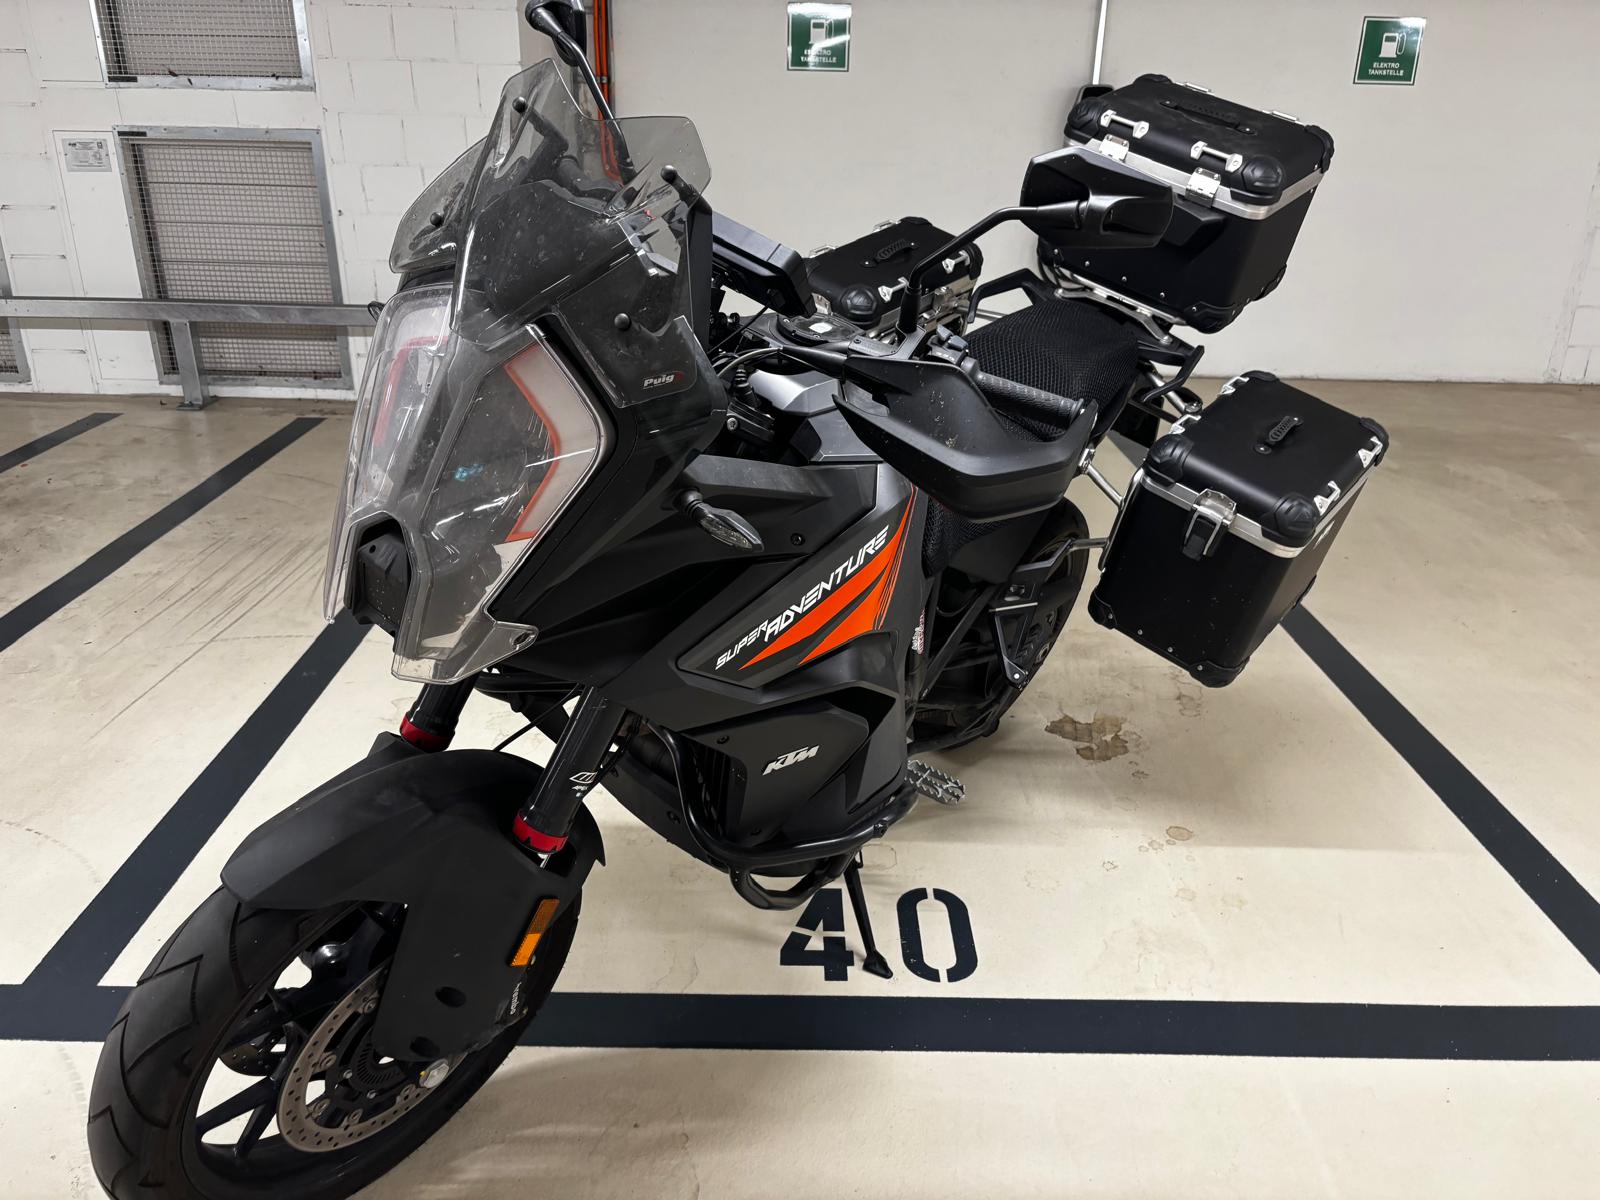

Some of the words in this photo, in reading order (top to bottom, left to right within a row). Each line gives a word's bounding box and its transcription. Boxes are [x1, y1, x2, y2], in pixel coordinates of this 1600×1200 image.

[643, 374, 675, 387] Puig
[715, 619, 769, 670] SUPER
[764, 524, 890, 642] ADVENTURE
[762, 745, 820, 776] KTM
[780, 887, 978, 983] 40
